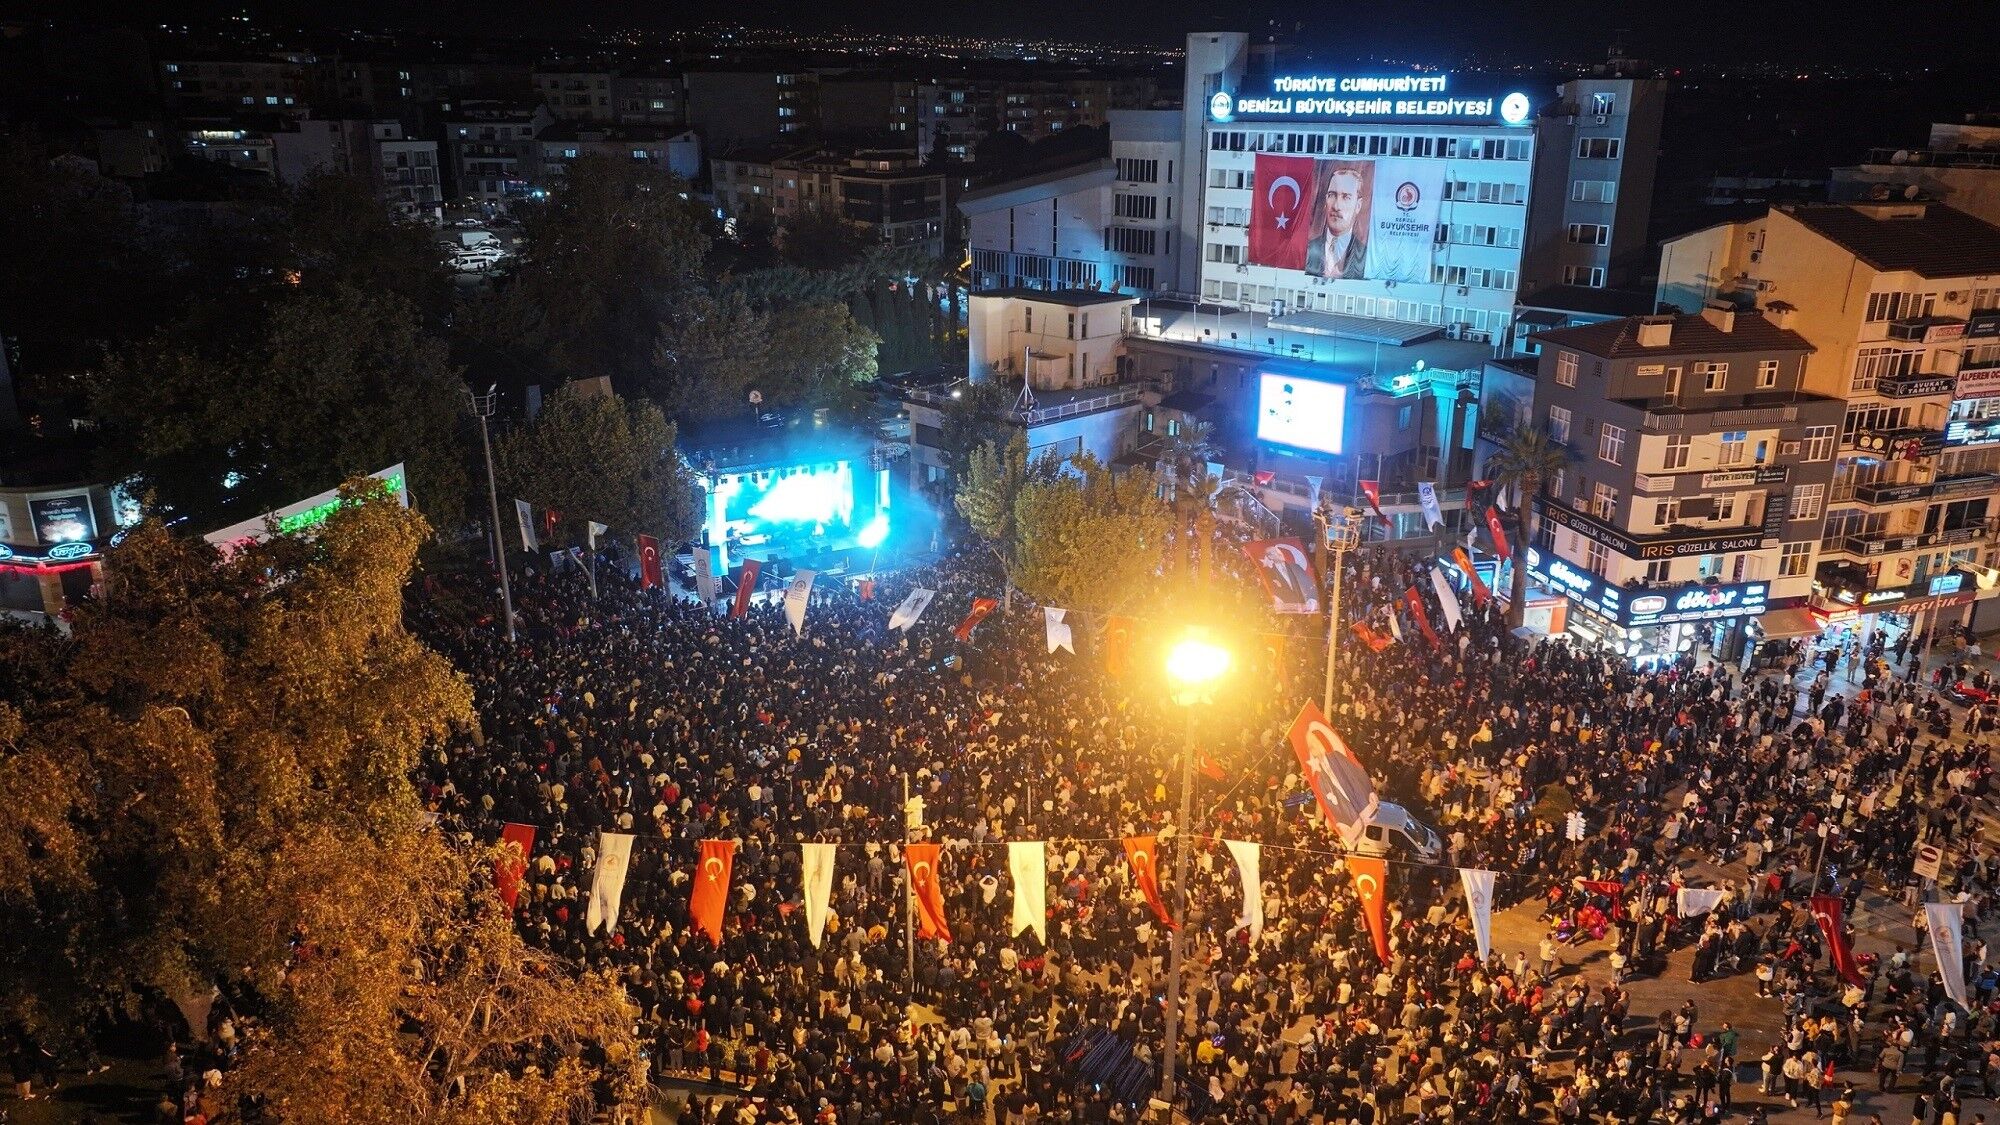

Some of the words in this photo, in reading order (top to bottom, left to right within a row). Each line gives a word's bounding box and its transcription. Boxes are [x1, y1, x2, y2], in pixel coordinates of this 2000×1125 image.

[1274, 76, 1336, 92] TÜRKİYE
[1340, 75, 1446, 92] CUMHURİYETİ
[1238, 97, 1292, 113] DENİZLİ
[1295, 98, 1392, 117] BÜYÜKŞEHİR
[1396, 98, 1492, 115] BELEDİYESİ
[1914, 381, 1944, 389] AVUKAT
[1570, 518, 1599, 538] GÜZELLİK
[1601, 532, 1628, 551] SALONU
[1677, 541, 1717, 554] GÜZELLİK
[1722, 538, 1757, 550] SALONU
